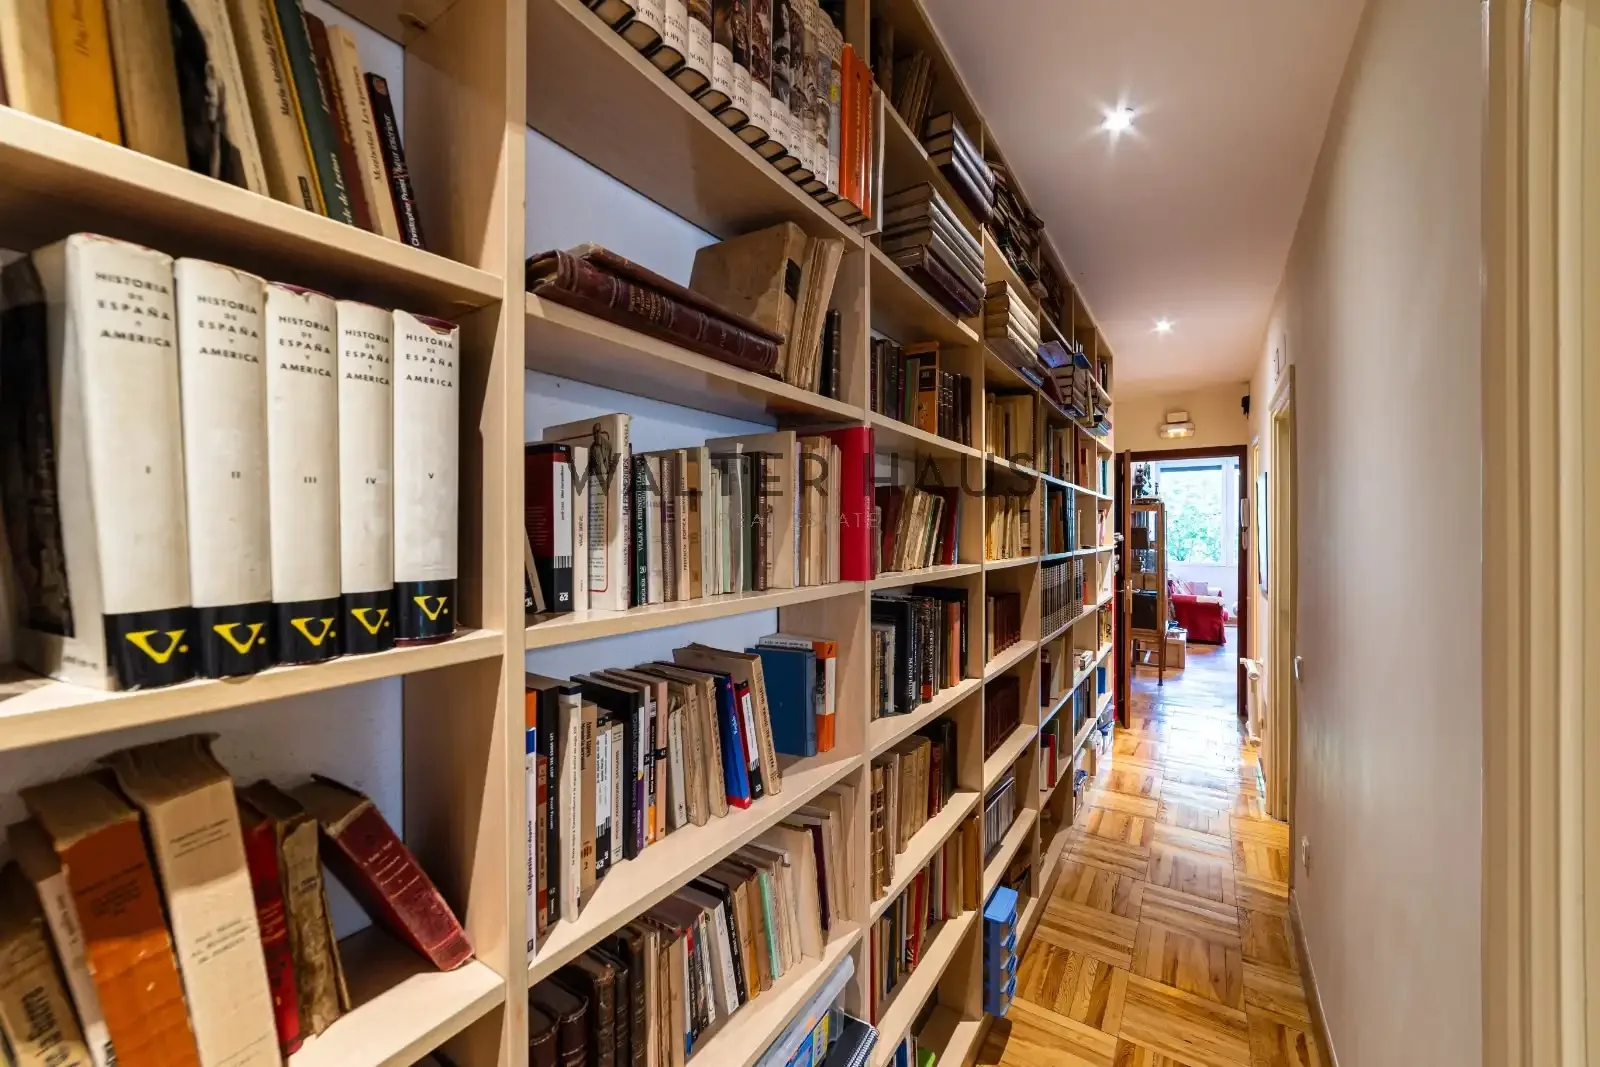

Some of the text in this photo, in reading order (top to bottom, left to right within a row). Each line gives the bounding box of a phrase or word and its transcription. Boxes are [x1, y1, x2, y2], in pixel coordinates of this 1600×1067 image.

[401, 200, 421, 247] Christopher
[95, 272, 170, 296] HISTORIA
[97, 299, 172, 321] ESPAÑA
[197, 295, 258, 315] HISTORIA
[198, 320, 260, 339] ESPAÑA
[278, 315, 330, 332] HISTORIA
[100, 329, 172, 348] AMERICA
[345, 329, 390, 344] HISTORIA
[406, 333, 454, 349] HISTORIA
[279, 338, 332, 354] ESPAÑA
[199, 347, 260, 364] AMERICA
[345, 350, 390, 365] ESPAÑA
[406, 353, 454, 368] ESPAÑA
[280, 362, 333, 377] AMERICA
[346, 372, 391, 386] AMERICA
[406, 374, 454, 388] AMERICA
[303, 475, 317, 484] III
[365, 477, 376, 485] IV
[526, 857, 534, 891] Magnesio
